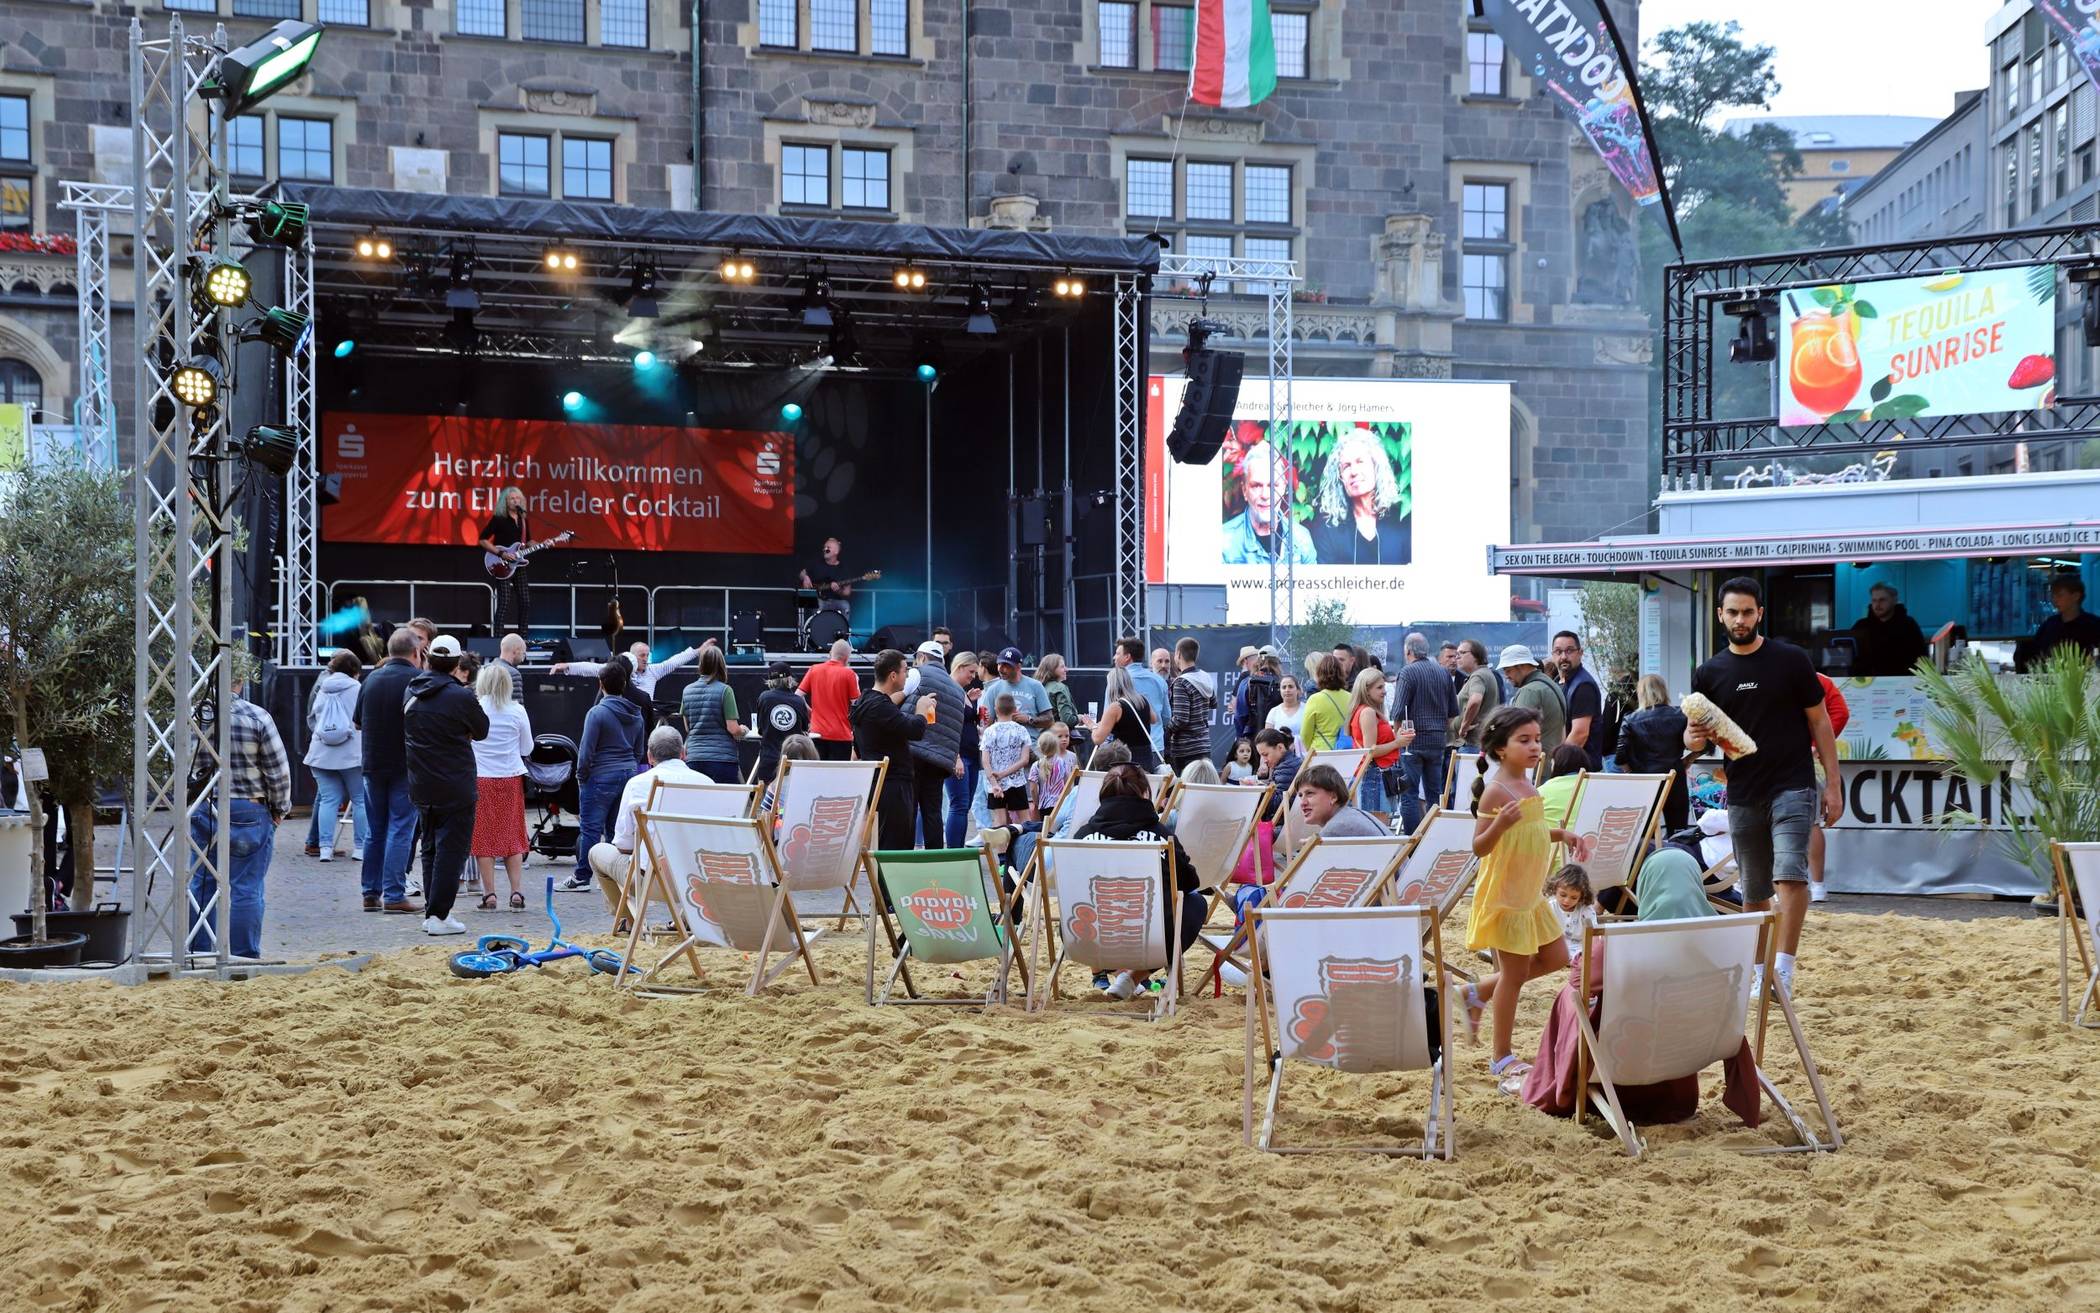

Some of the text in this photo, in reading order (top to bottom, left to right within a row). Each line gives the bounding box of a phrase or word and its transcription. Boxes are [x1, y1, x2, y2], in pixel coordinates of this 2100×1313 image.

[1887, 286, 1996, 346] TEQUILA
[1888, 321, 2006, 384] SUNRISE
[1236, 401, 1271, 411] Andrea
[1276, 401, 1323, 412] Scleicher
[434, 452, 703, 485] Herzlich willkommen
[405, 487, 721, 519] zum Elrfelder Cocktail
[1505, 555, 1521, 566] SEX
[1522, 555, 1534, 565] ON
[1535, 554, 1551, 565] THE
[1553, 553, 1580, 564] BEACH
[1587, 551, 1643, 563] TOUCHDOWN
[1651, 549, 1686, 561] TEQUILA
[1689, 547, 1728, 560] SUNRISE
[1735, 546, 1752, 557] MAI
[1753, 545, 1769, 556] TAI
[1776, 542, 1831, 555] CAIPIRINHA
[1838, 540, 1892, 553] SWIMMING
[1894, 538, 1920, 550] POOL
[1928, 537, 1951, 549] PINA
[1955, 536, 1994, 548] COLADA
[2002, 534, 2030, 546] LONG
[2033, 532, 2070, 544] ISLAND
[2073, 531, 2089, 543] ICE
[1840, 768, 2054, 826] CKTAIL
